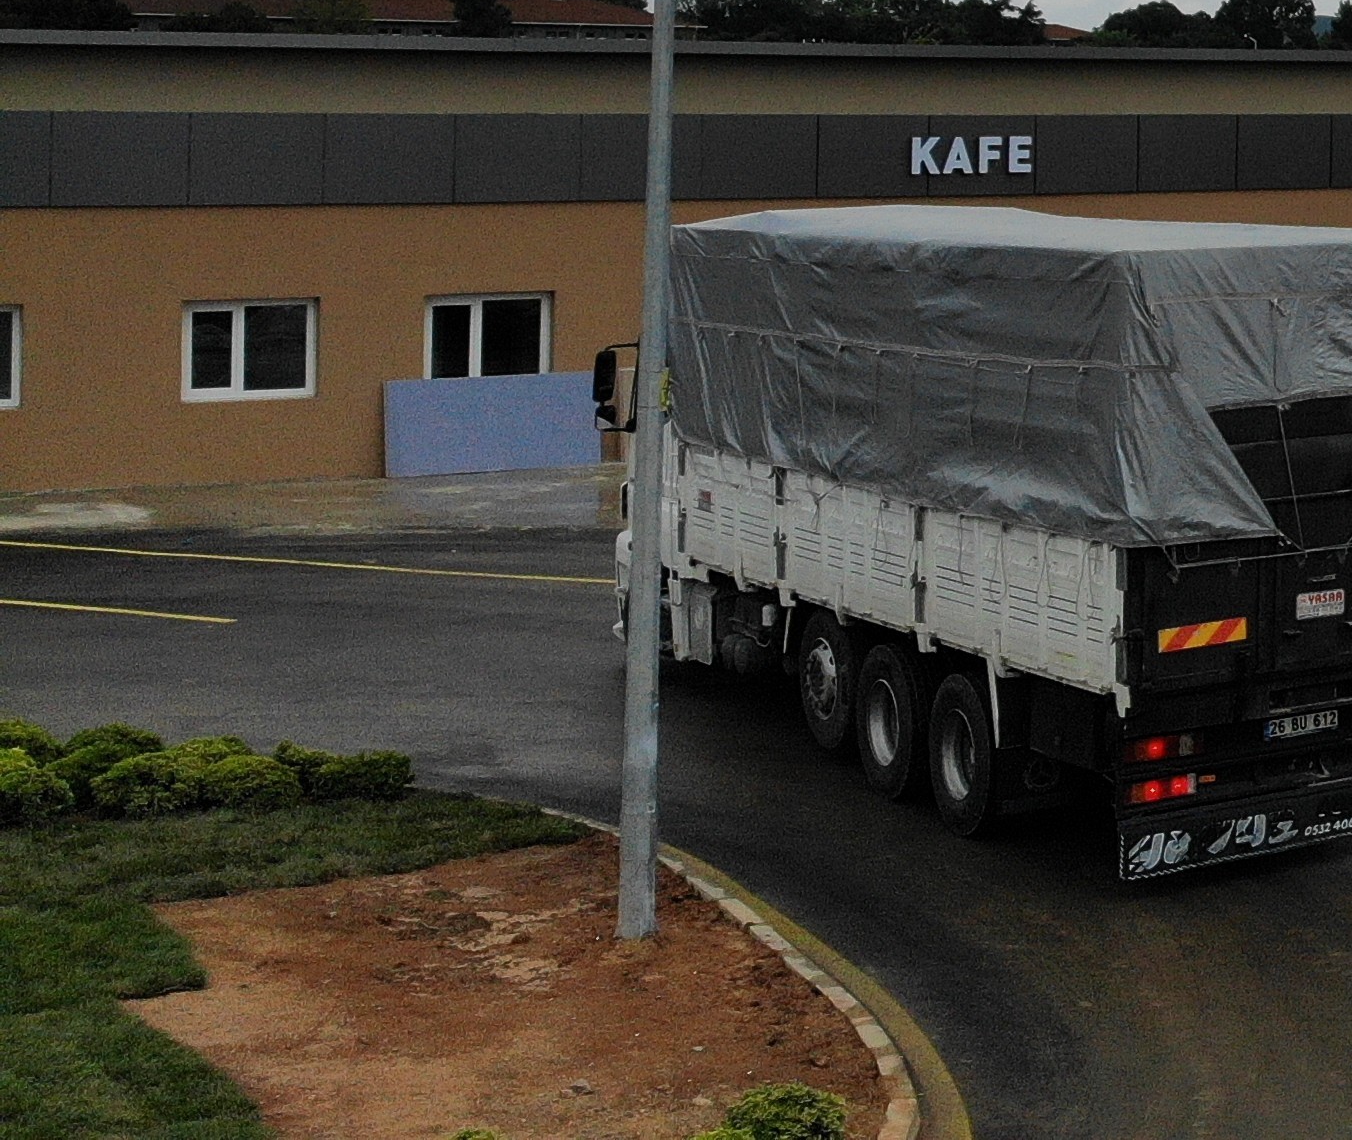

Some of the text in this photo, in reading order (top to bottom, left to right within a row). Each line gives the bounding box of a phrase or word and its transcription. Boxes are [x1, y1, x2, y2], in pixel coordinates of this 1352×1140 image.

[911, 136, 1032, 175] KAFE
[1270, 720, 1285, 736] 26
[1313, 711, 1337, 728] 612
